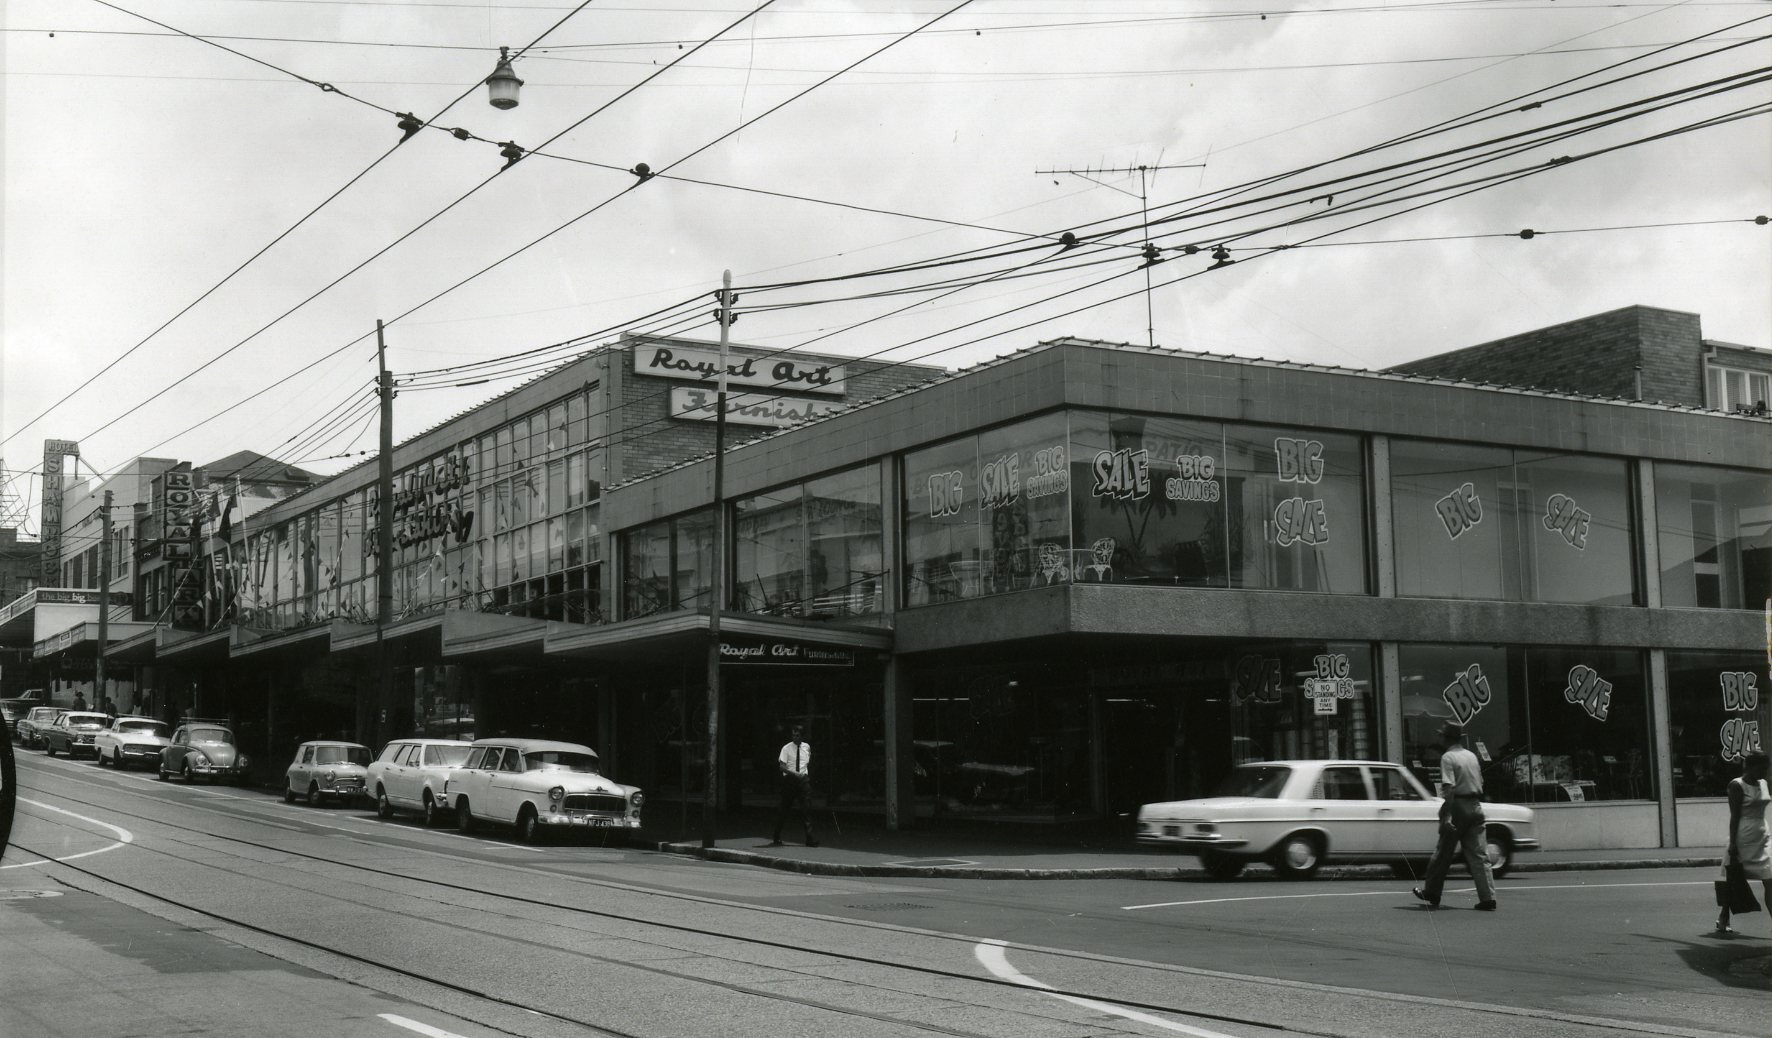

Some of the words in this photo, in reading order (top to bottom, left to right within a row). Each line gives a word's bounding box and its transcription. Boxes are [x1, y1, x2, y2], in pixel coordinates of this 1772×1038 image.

[650, 348, 757, 380] Royal
[772, 360, 832, 386] Art
[48, 441, 78, 453] HOTEL
[1035, 446, 1065, 477] BIG
[1176, 455, 1214, 481] BIG
[1275, 437, 1324, 484] BIG
[929, 470, 963, 518] BIG
[981, 451, 1019, 510] SALE
[1027, 470, 1068, 500] SAVINGS
[1092, 447, 1150, 500] SALE
[1166, 478, 1220, 502] SAVINGS
[168, 473, 191, 558] ROYAL
[1275, 498, 1329, 546] SALE
[1434, 482, 1483, 540] BIG
[1542, 493, 1591, 551] SALE
[42, 593, 54, 601] the
[58, 593, 70, 602] big
[72, 593, 86, 603] big
[720, 643, 765, 660] Royal
[771, 643, 800, 657] Art
[1314, 654, 1349, 679] BIG
[1236, 654, 1282, 704] SALE
[1320, 684, 1331, 692] NO
[1443, 663, 1491, 726] BIG
[1564, 663, 1612, 722] SALE
[1720, 671, 1758, 711] BIG
[1720, 718, 1762, 762] SALE
